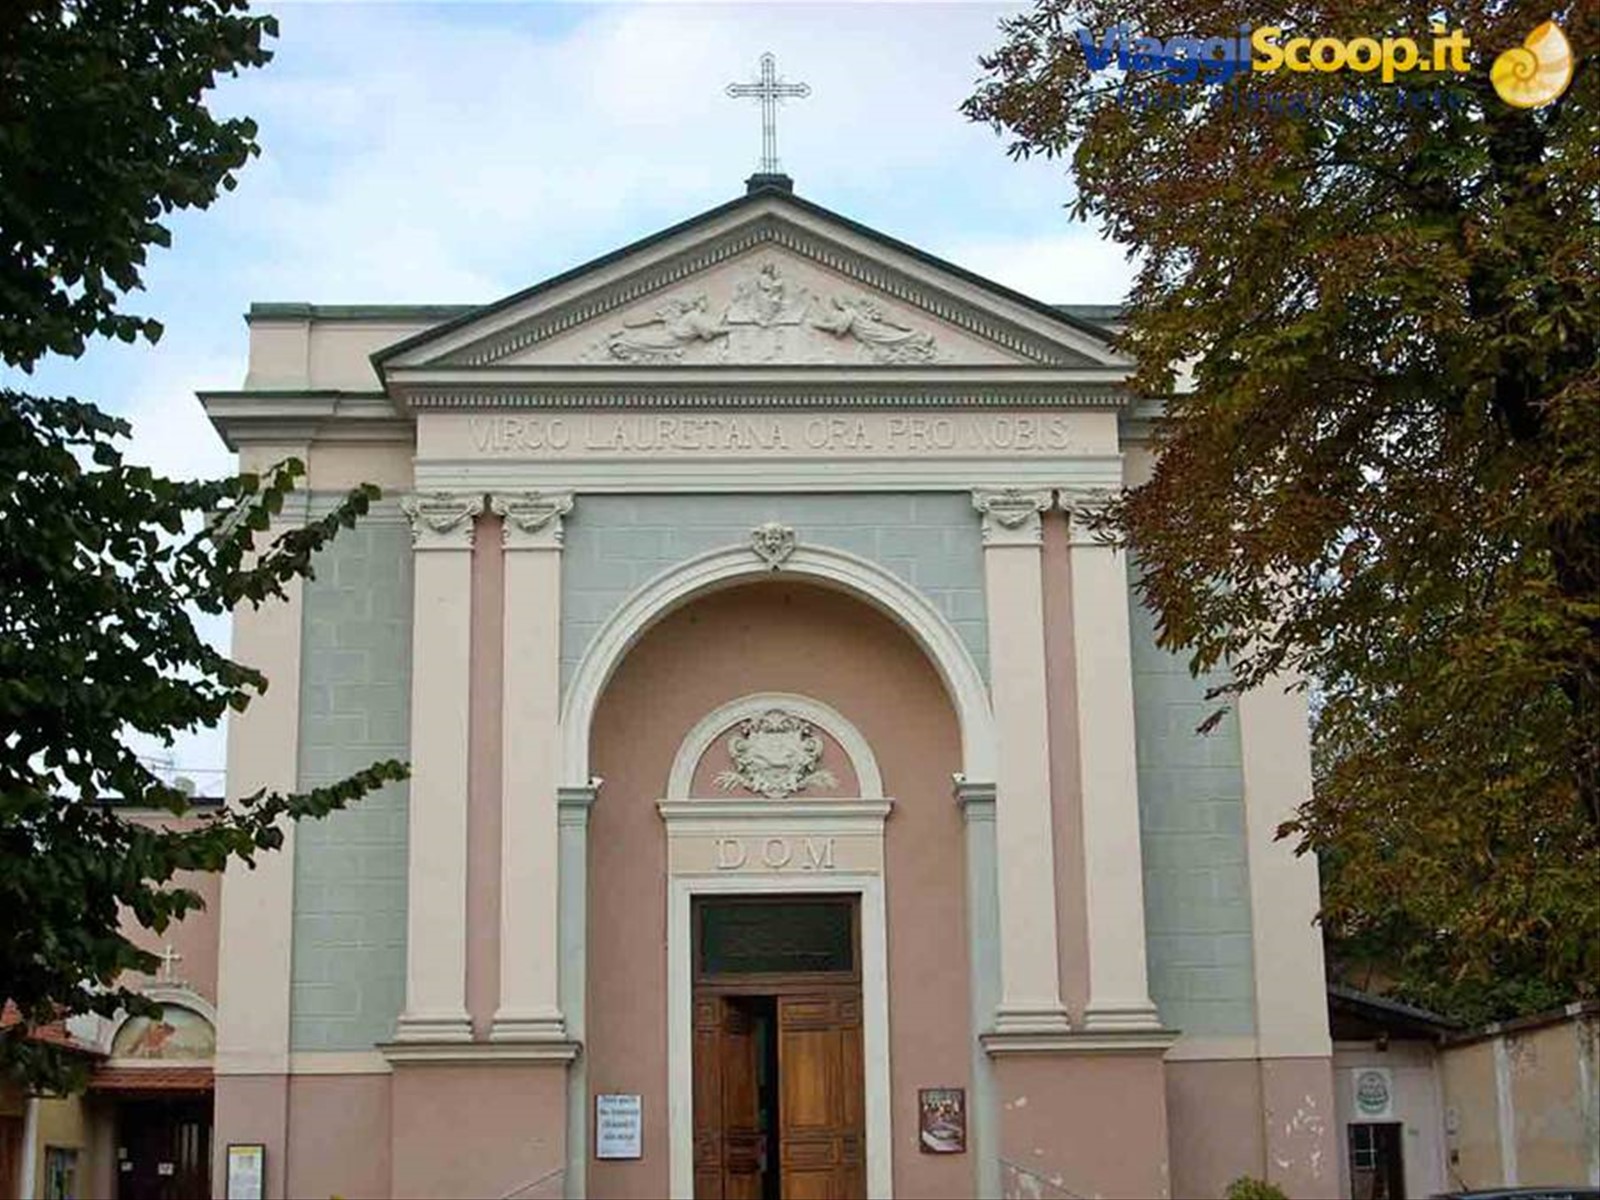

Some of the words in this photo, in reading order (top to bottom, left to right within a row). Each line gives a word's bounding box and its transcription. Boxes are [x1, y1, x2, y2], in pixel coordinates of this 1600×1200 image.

[585, 415, 789, 451] LAURETANA
[804, 414, 875, 451] ORA
[886, 414, 955, 451] PRO
[963, 414, 1071, 451] NOBIS
